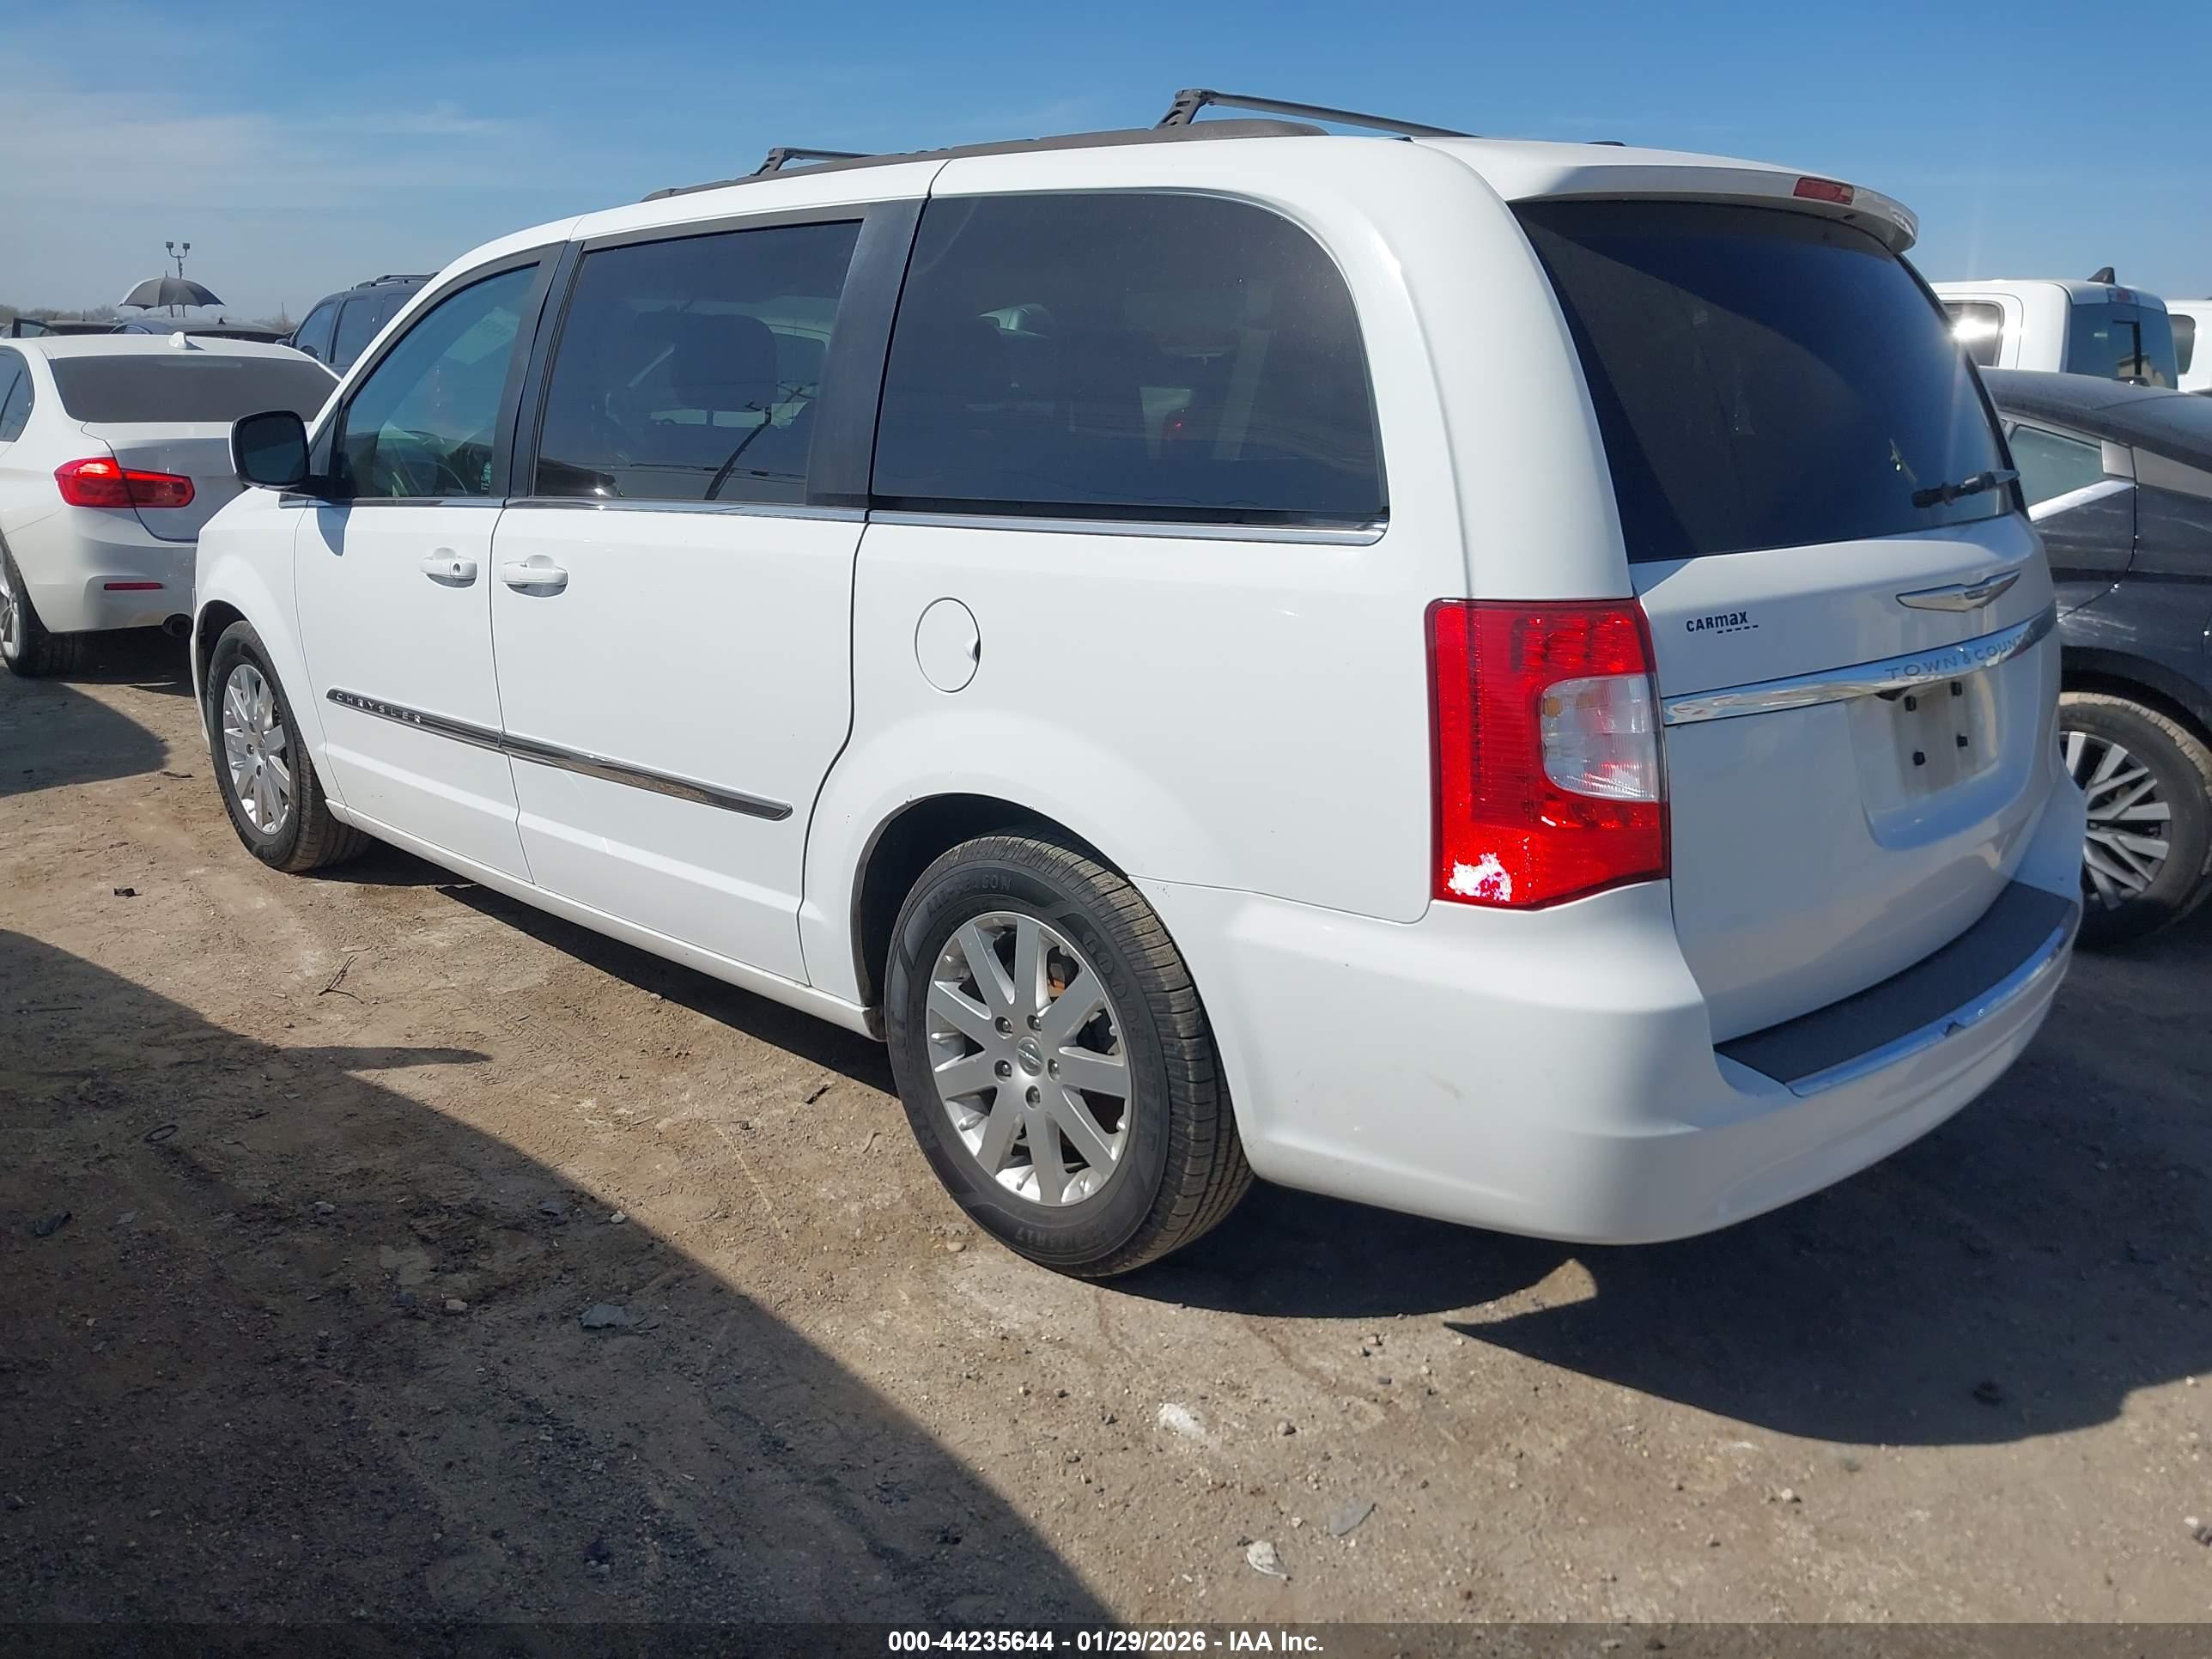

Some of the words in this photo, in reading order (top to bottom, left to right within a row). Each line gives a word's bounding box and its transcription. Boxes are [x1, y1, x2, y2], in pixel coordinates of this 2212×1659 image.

[1884, 655, 1959, 680] TOWN
[1961, 650, 1972, 665] &
[1974, 633, 2025, 660] COUNT
[335, 691, 422, 724] CHRYSLER
